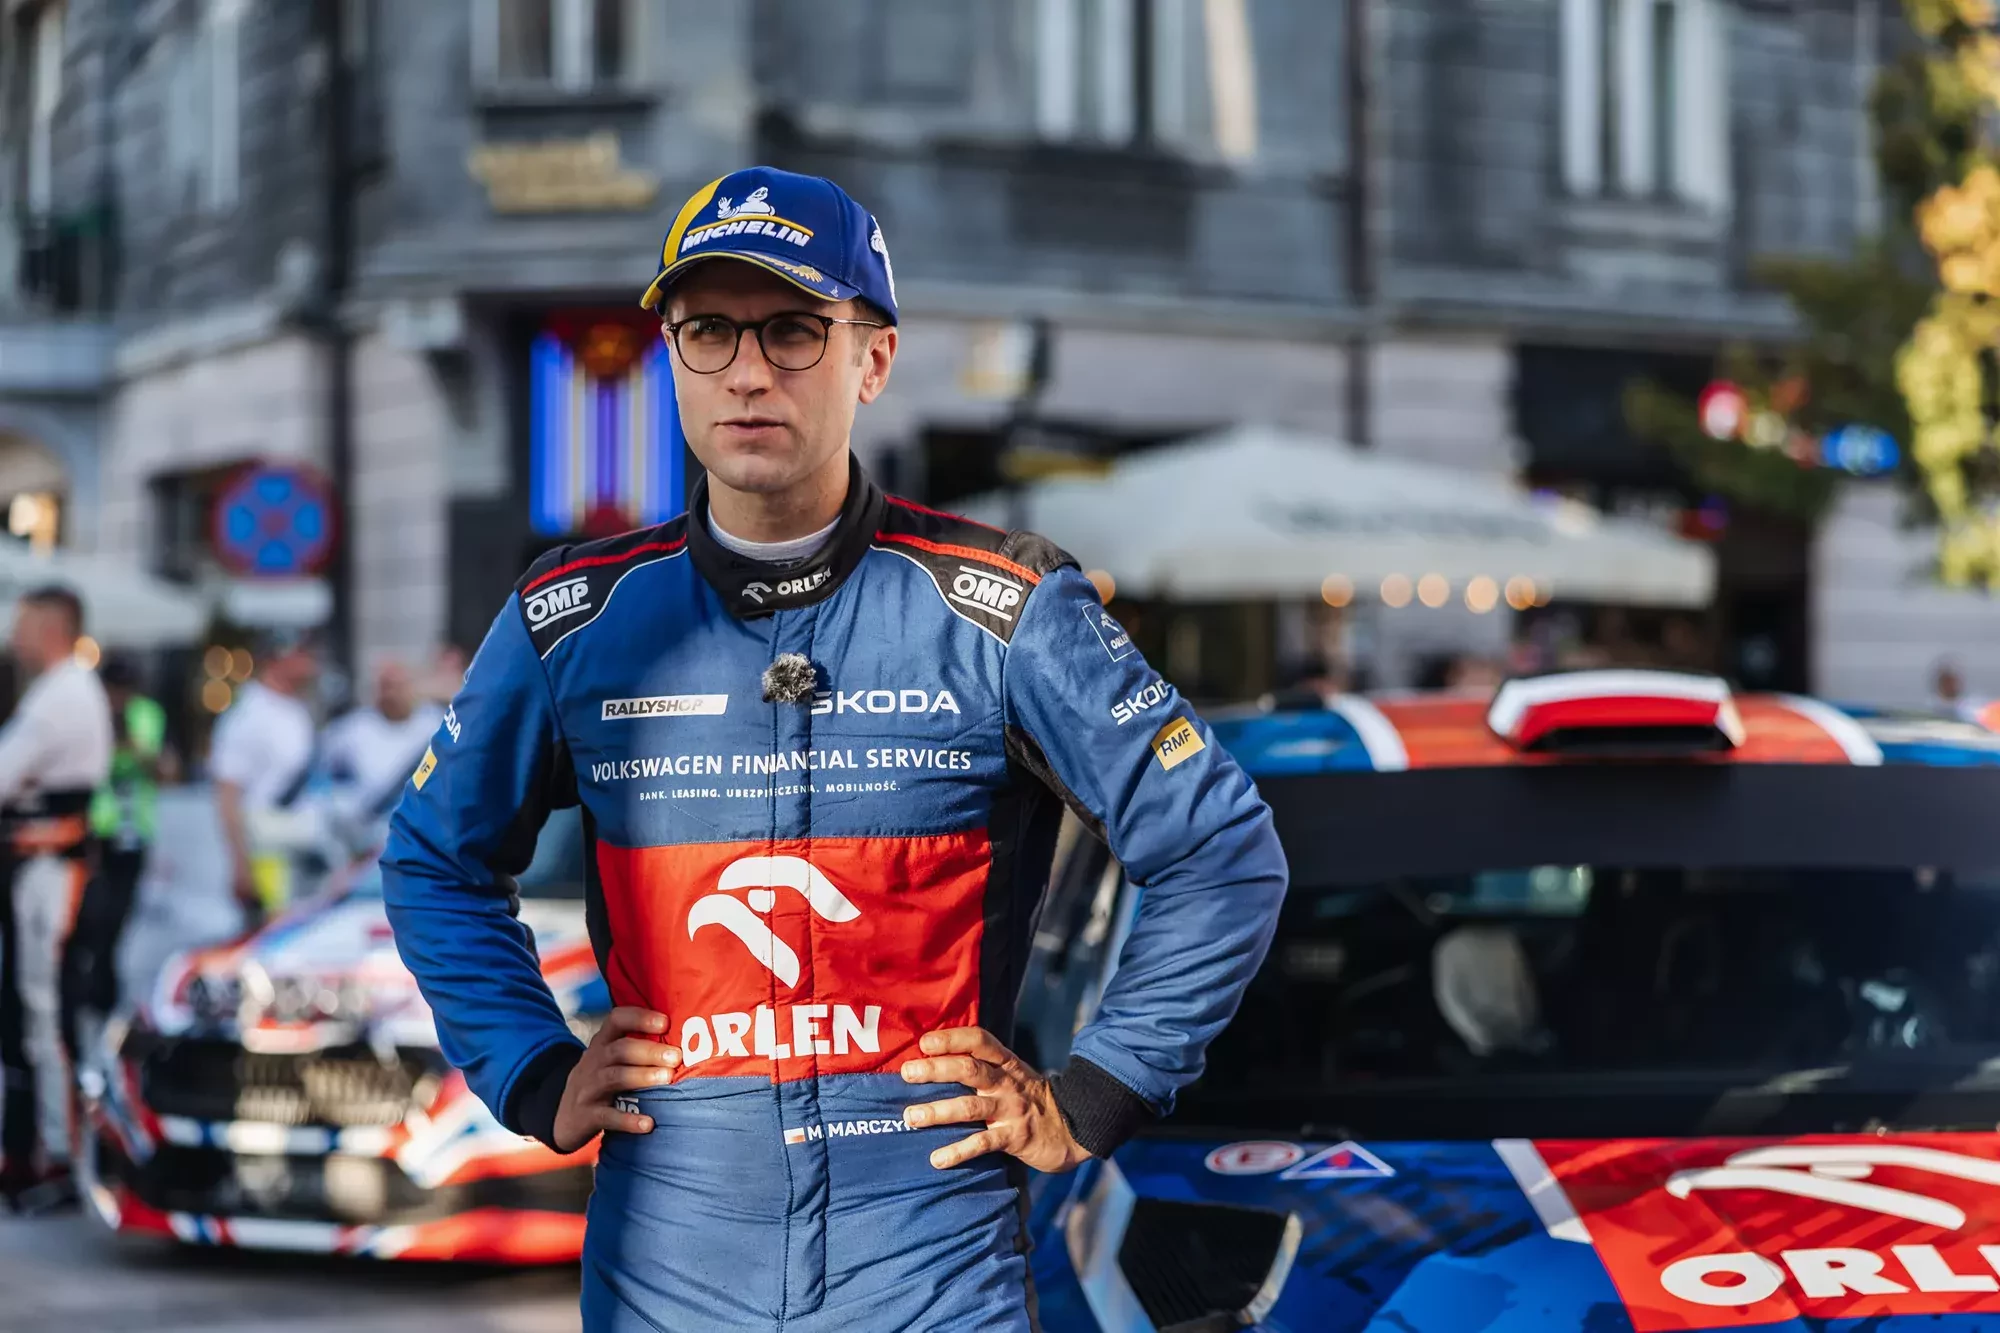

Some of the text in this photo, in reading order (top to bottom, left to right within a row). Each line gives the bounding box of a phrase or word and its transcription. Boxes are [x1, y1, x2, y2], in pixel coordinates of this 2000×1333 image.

[681, 220, 811, 253] MICHELIN
[776, 566, 832, 596] ORLEN
[953, 573, 1020, 611] OMP
[526, 582, 589, 622] OMP
[605, 699, 704, 717] RALLYSHOP
[1110, 678, 1172, 726] SKOD
[1160, 728, 1191, 757] RMF
[592, 748, 972, 783] VOLKSWAGEN FINANCIAL SERVICES
[640, 791, 667, 801] BANK.
[672, 788, 721, 798] LEASING.
[826, 780, 901, 793] MOBILNOŚĆ.
[681, 1004, 882, 1068] ORLEN
[828, 1119, 918, 1138] MARCZY
